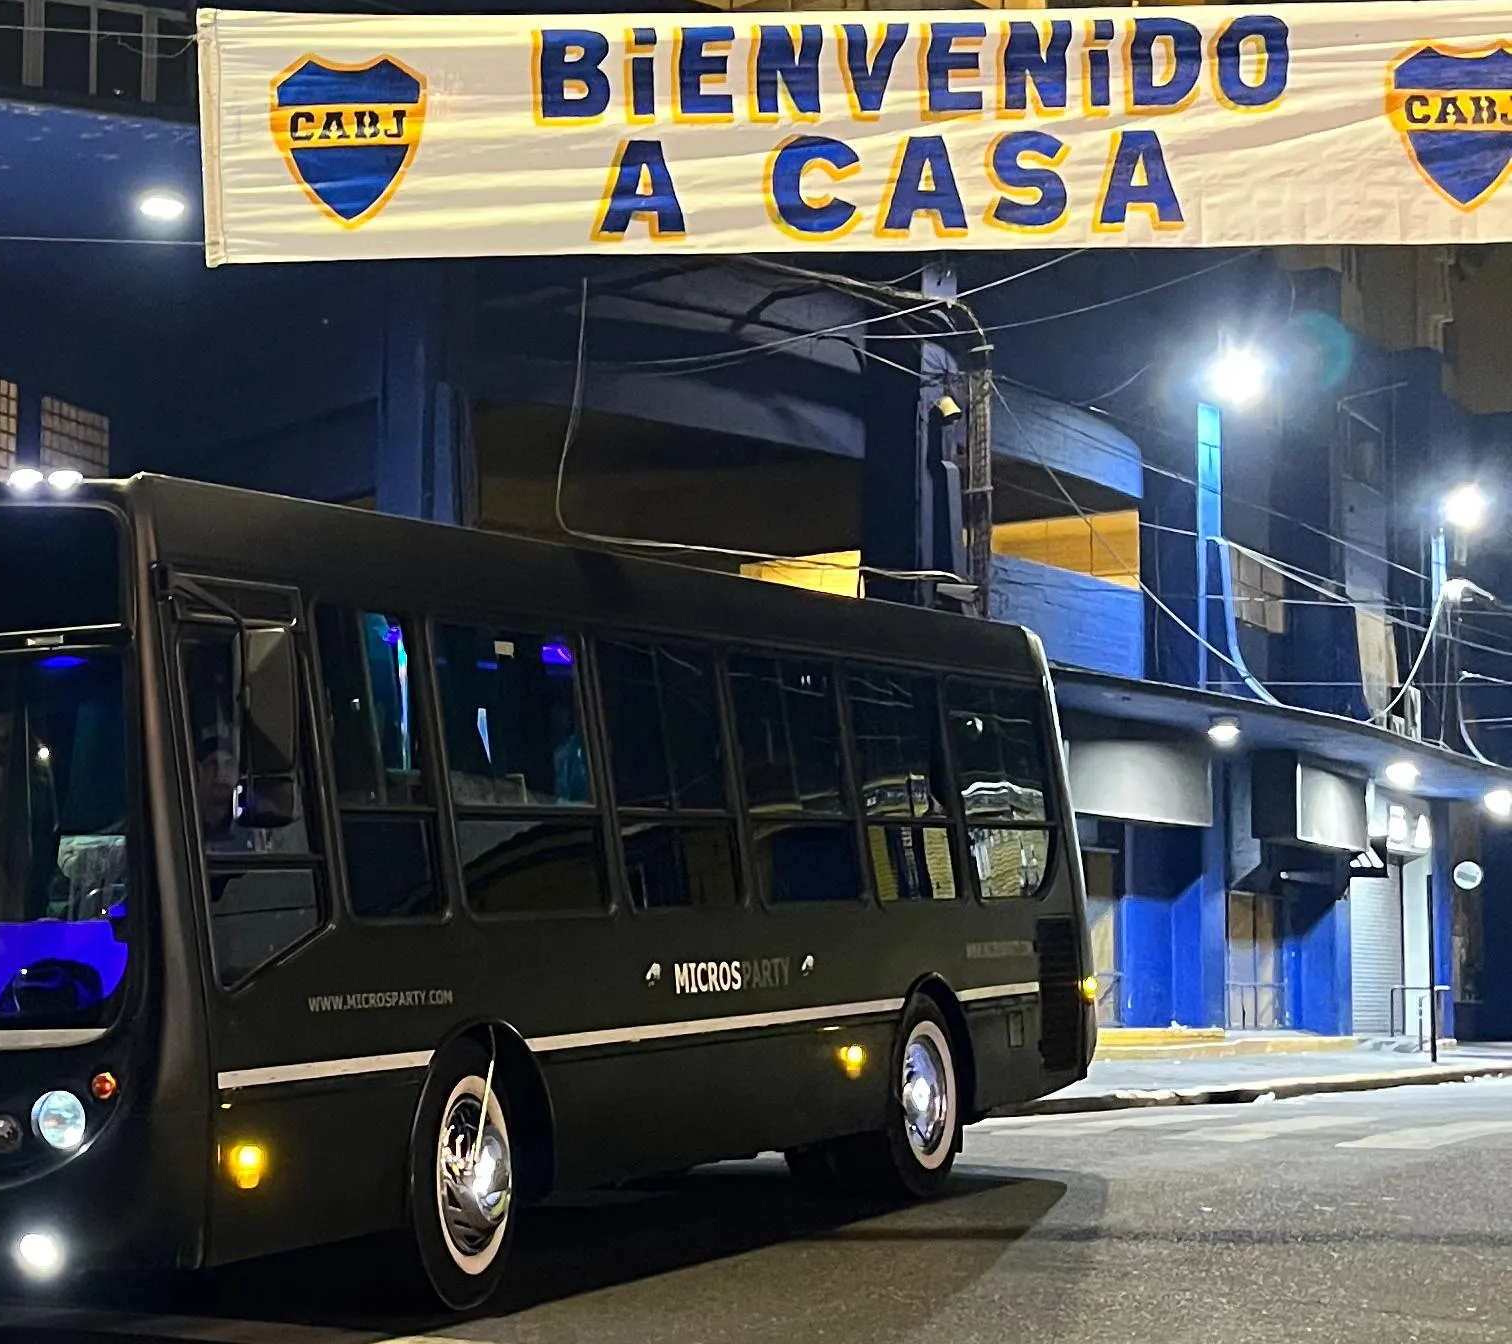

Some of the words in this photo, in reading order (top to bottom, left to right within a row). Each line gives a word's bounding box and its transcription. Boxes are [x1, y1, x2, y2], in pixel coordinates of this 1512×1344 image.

[289, 109, 407, 141] CABJ
[590, 139, 686, 241] A
[763, 130, 1185, 241] CASA
[308, 990, 453, 1012] WWW.MICROSPARTY.COM
